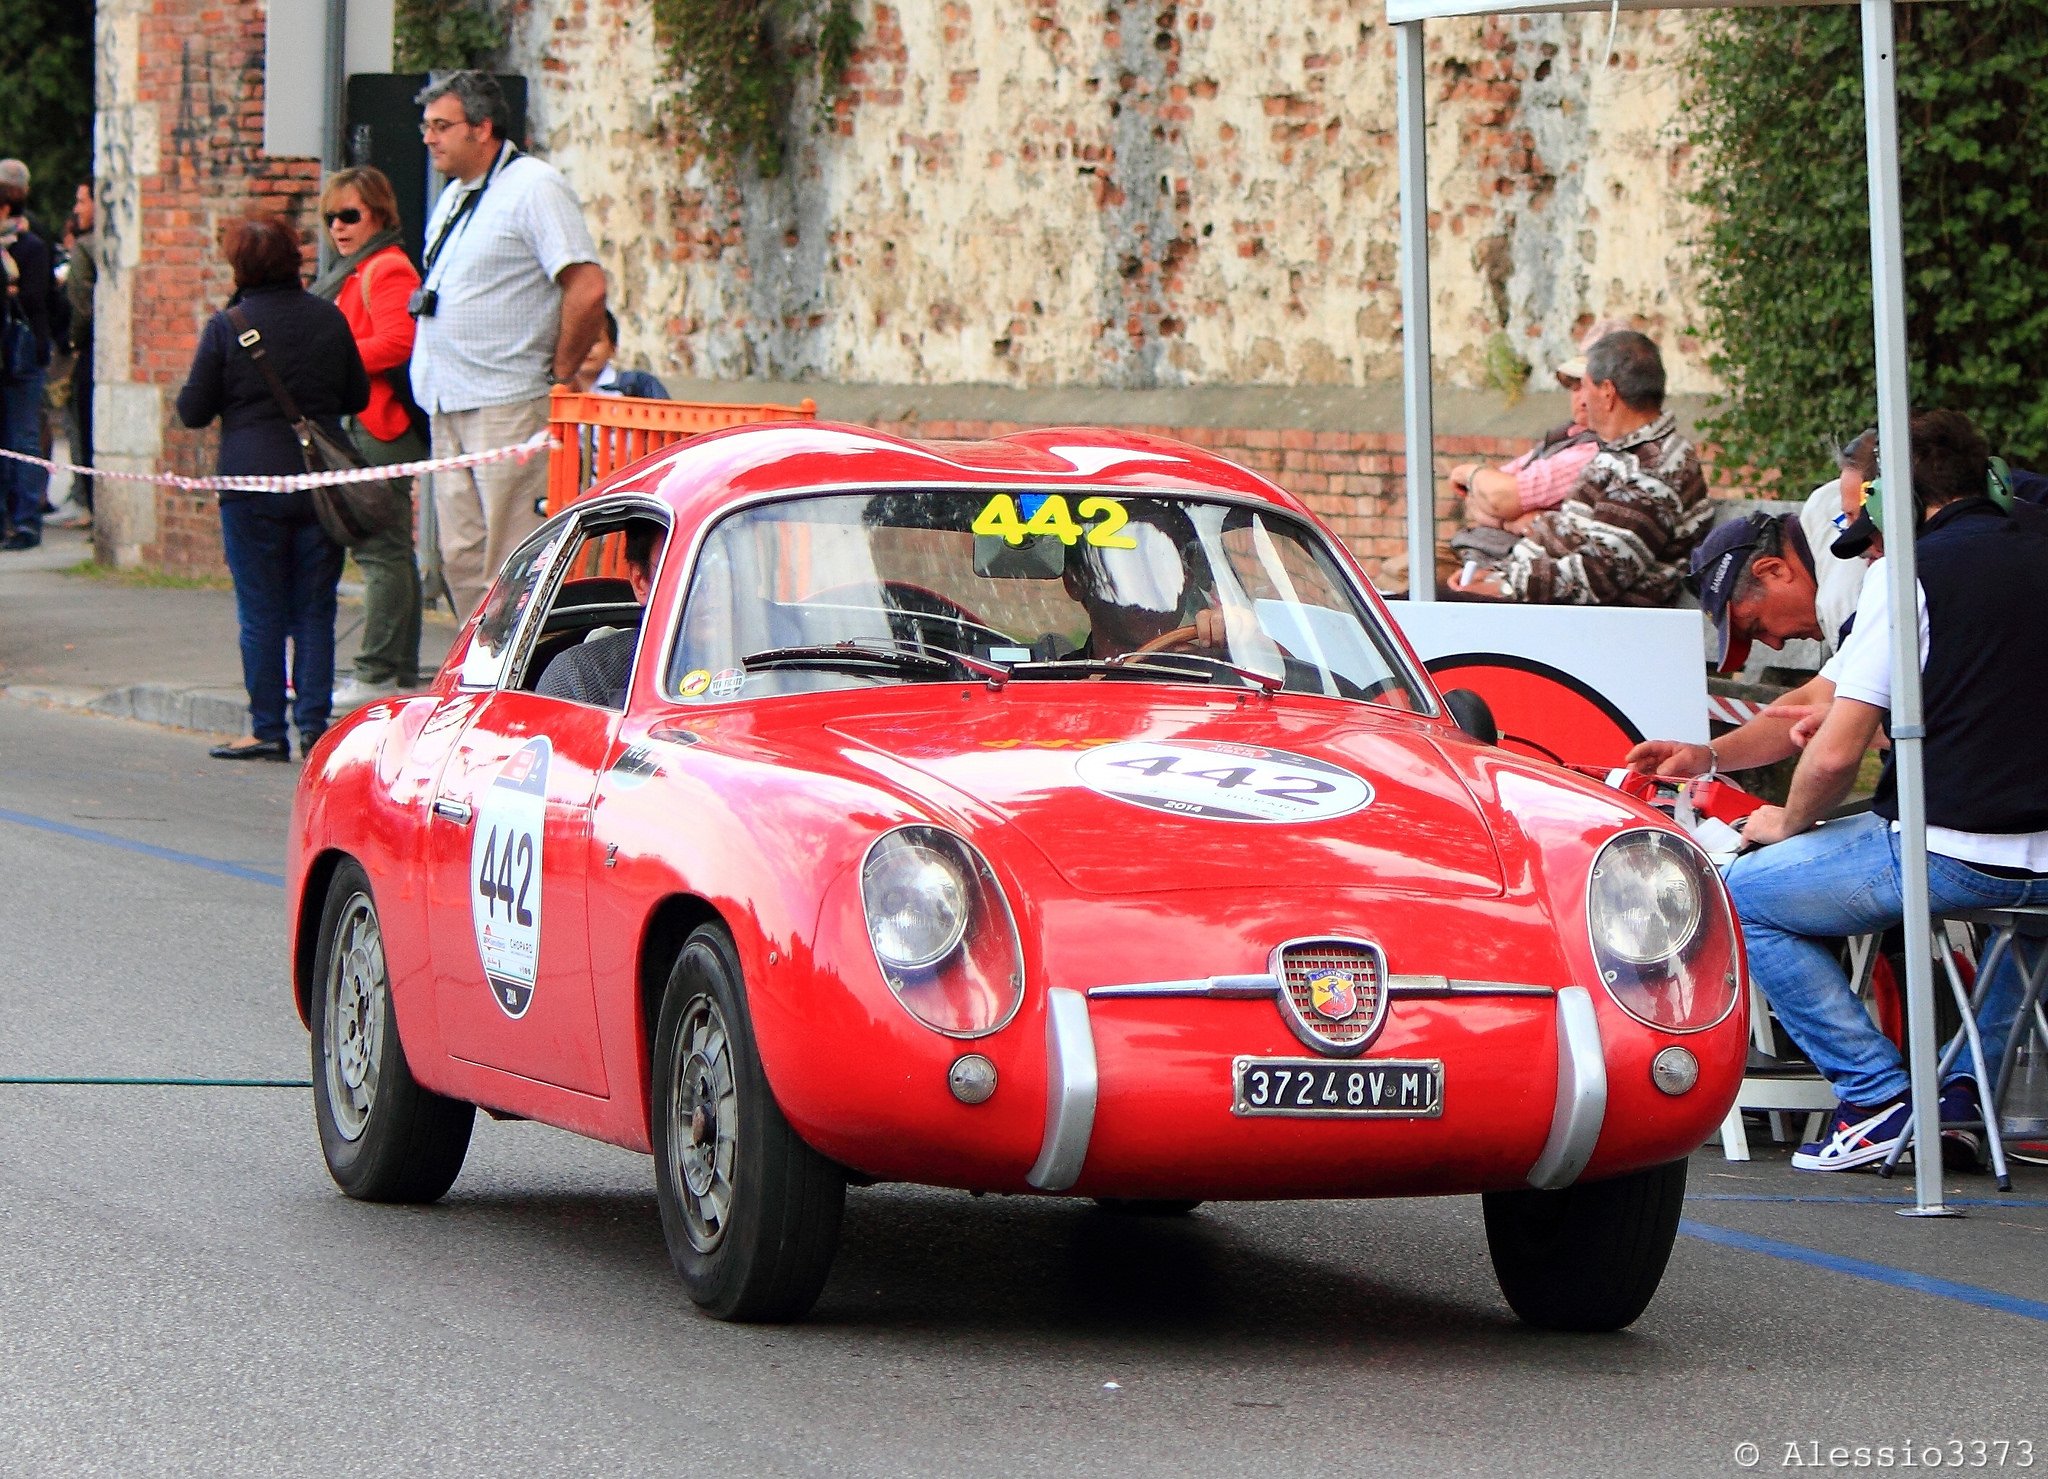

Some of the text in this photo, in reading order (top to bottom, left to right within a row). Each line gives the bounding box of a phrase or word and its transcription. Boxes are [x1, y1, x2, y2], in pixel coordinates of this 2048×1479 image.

[971, 493, 1137, 549] 442
[1106, 755, 1337, 806] 442
[1163, 800, 1203, 814] 2014
[479, 823, 533, 928] 442
[1251, 1071, 1385, 1106] 37248V
